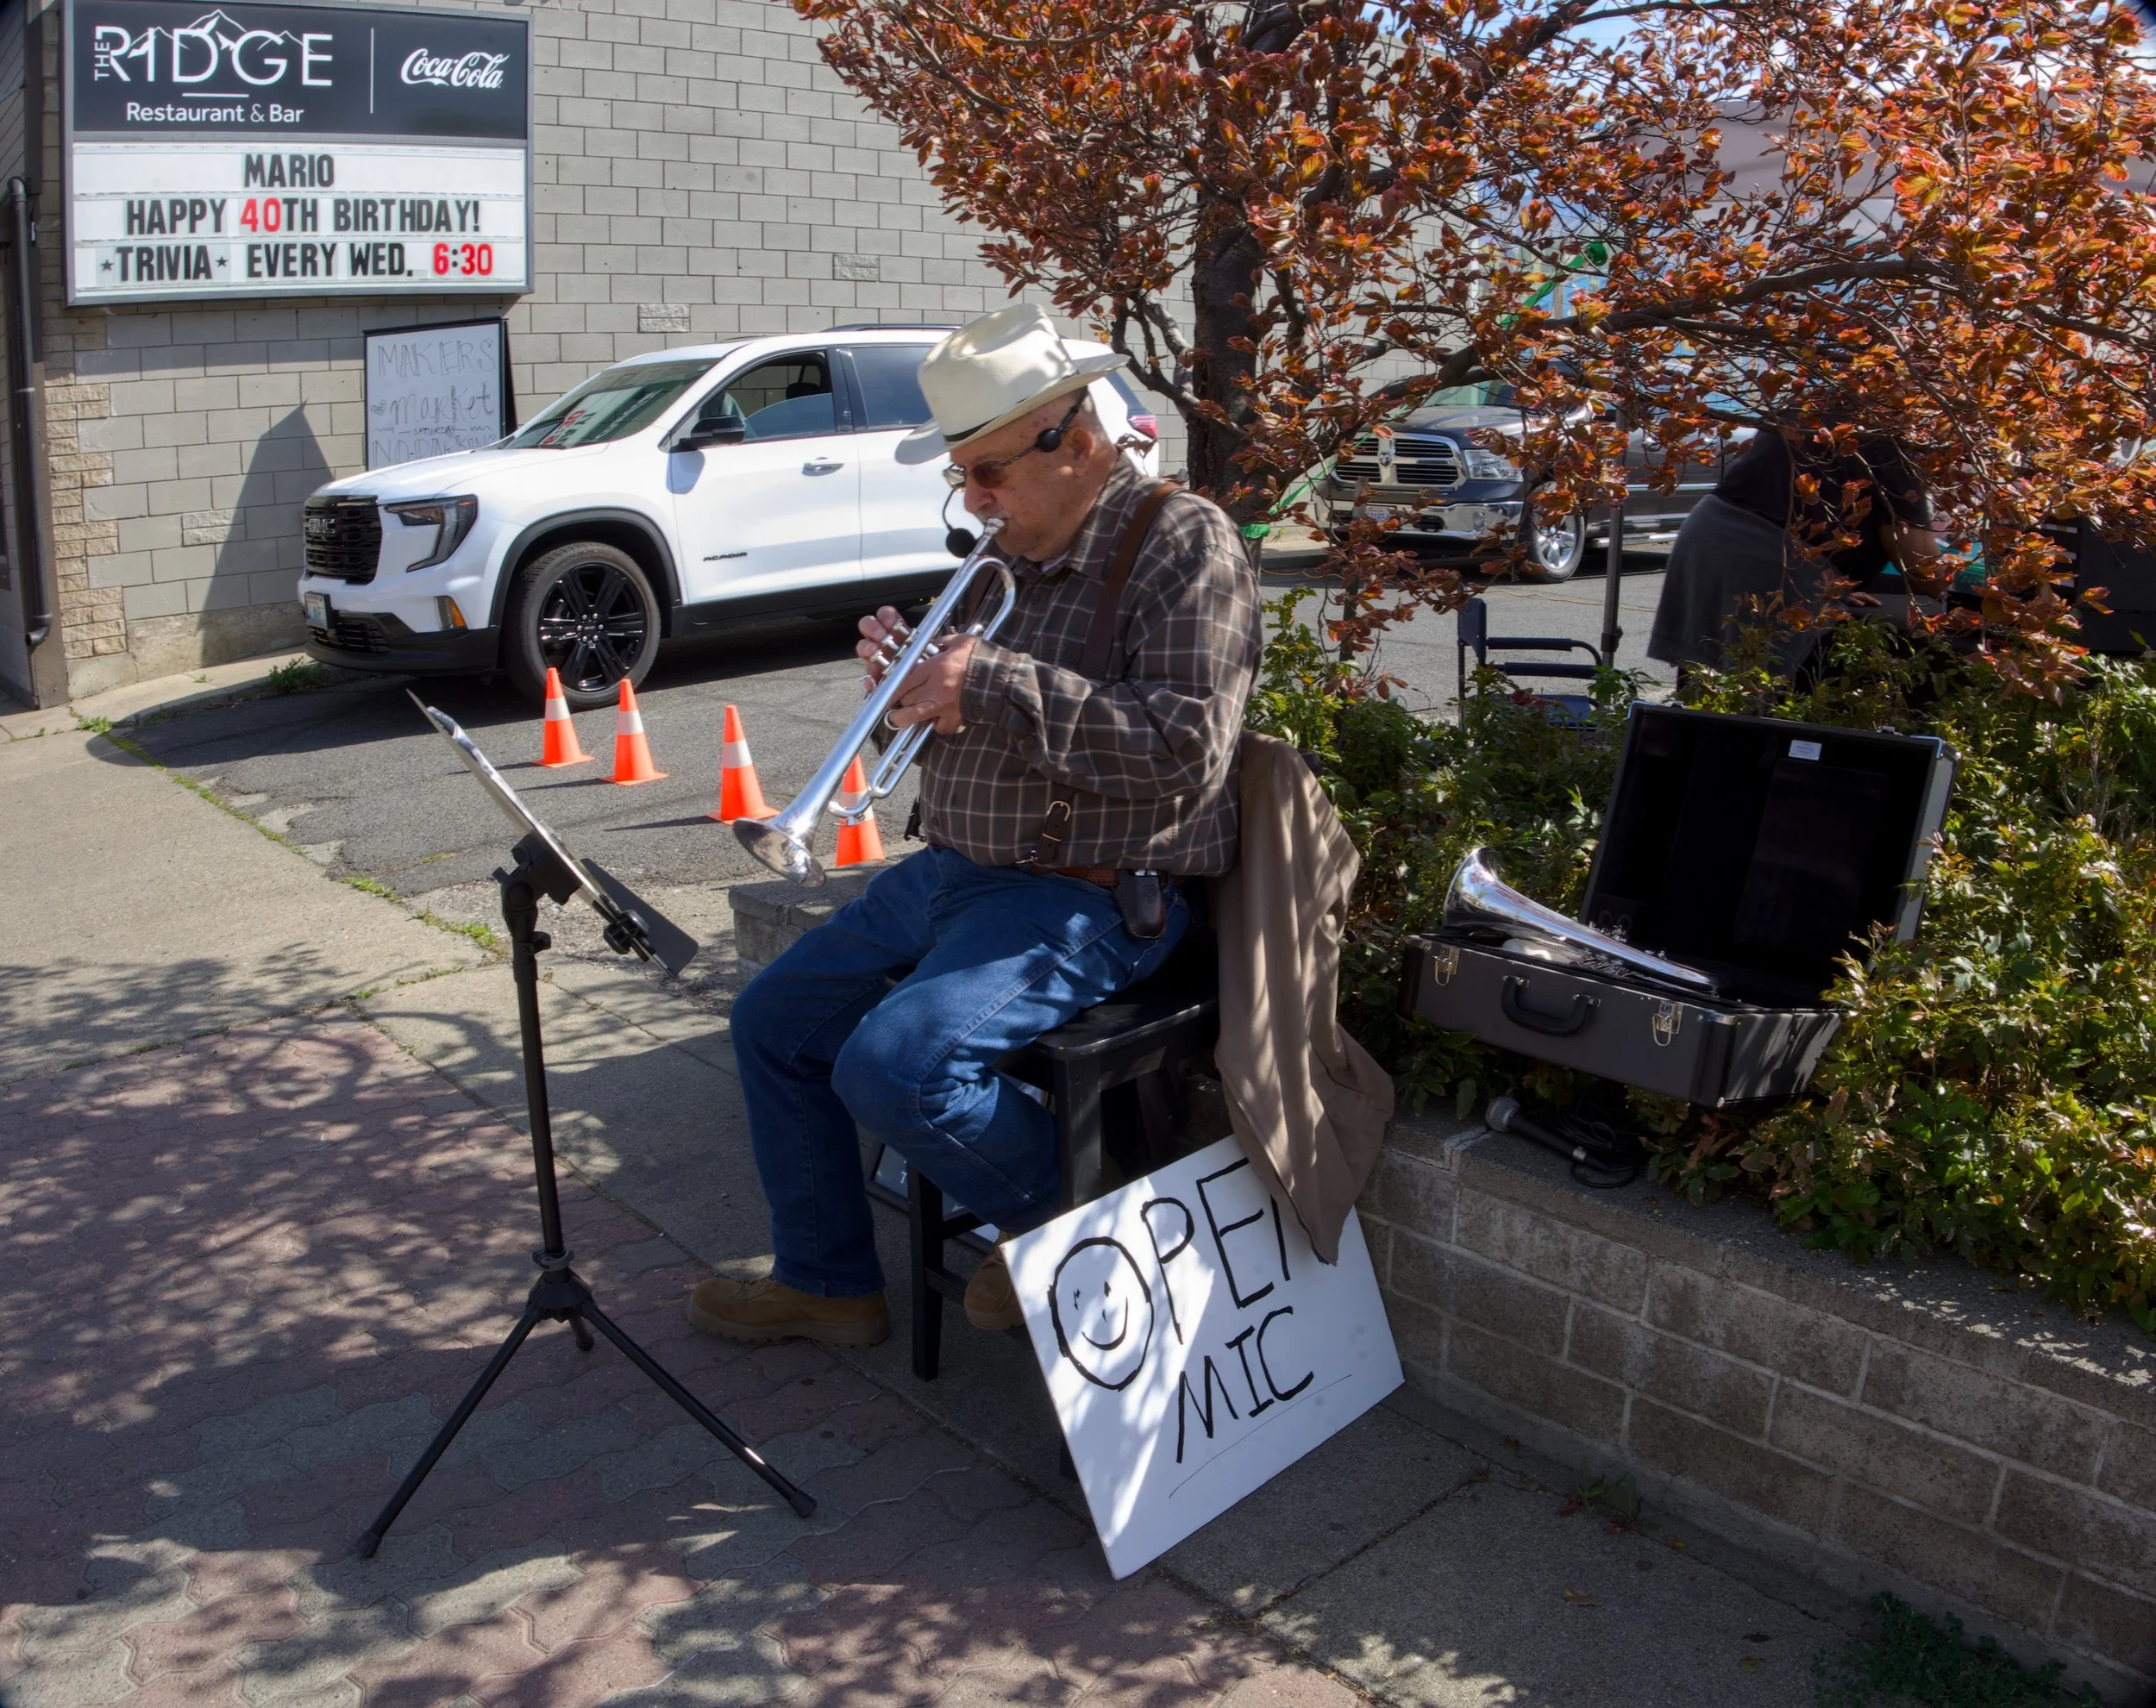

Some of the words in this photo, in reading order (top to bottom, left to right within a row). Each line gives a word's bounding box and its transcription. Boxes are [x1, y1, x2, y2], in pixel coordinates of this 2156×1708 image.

[94, 42, 110, 81] THE
[96, 25, 333, 86] RIDGE
[401, 48, 511, 89] Coca-Cola
[127, 102, 246, 122] Restaurant
[250, 103, 266, 122] &
[269, 104, 304, 122] Bar
[244, 153, 335, 188] MARIO
[127, 198, 227, 235] HAPPY
[241, 197, 318, 233] 40TH
[334, 198, 480, 232] BIRTHDAY!
[116, 245, 212, 282] TRIVIA
[248, 243, 337, 278] EVERY
[350, 242, 413, 277] WED.
[434, 242, 492, 276] 6:30
[378, 338, 496, 378] MAKERS
[703, 552, 748, 562] ACADIA
[1176, 1305, 1314, 1464] MIC
